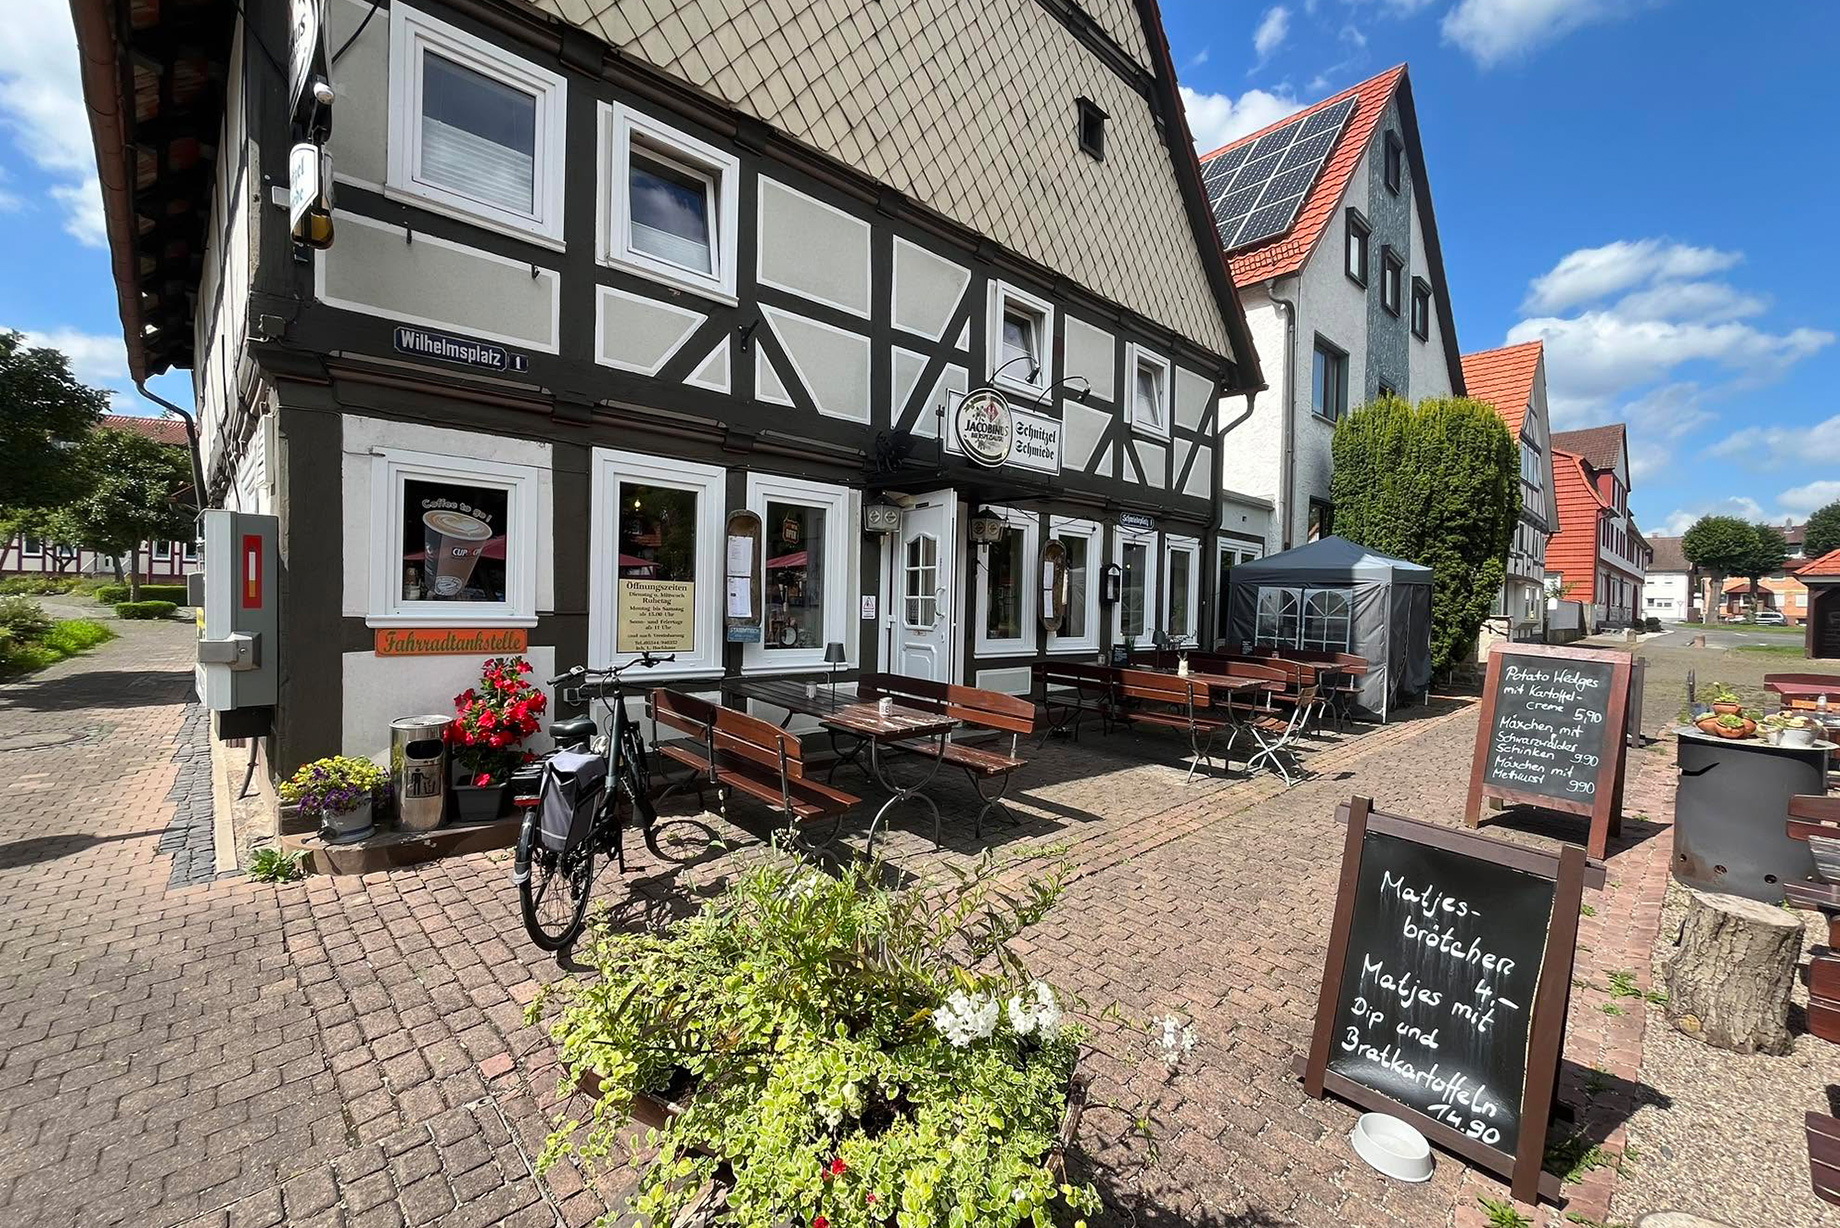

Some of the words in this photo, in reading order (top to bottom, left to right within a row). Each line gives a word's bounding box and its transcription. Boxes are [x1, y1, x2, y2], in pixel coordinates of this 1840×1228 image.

[400, 329, 501, 366] Wilhelmsplatz
[515, 356, 521, 369] 1
[1015, 421, 1057, 445] Schnitzel
[1015, 440, 1055, 460] Schmiede
[421, 498, 458, 509] Coffee
[459, 502, 472, 513] to
[626, 581, 687, 592] Öffnungszeiten
[642, 597, 672, 605] Ruhetag
[383, 630, 521, 652] Fahrradtankstelle
[1503, 683, 1524, 695] mit
[1505, 665, 1550, 681] Potato
[1553, 668, 1599, 692] Wedges
[1572, 708, 1603, 724] 5,90
[1559, 725, 1584, 738] mit
[1495, 743, 1555, 760] Schinken
[1570, 753, 1599, 767] 9.90
[1550, 765, 1574, 778] mit
[1380, 870, 1481, 918] Matjes-
[1361, 952, 1442, 1009] Matjes
[1451, 1001, 1495, 1033] mit
[1350, 996, 1384, 1029] Dip
[1396, 1021, 1439, 1049] und
[1341, 1026, 1497, 1118] Bratkartoffeln
[1427, 1103, 1501, 1145] 14.90
